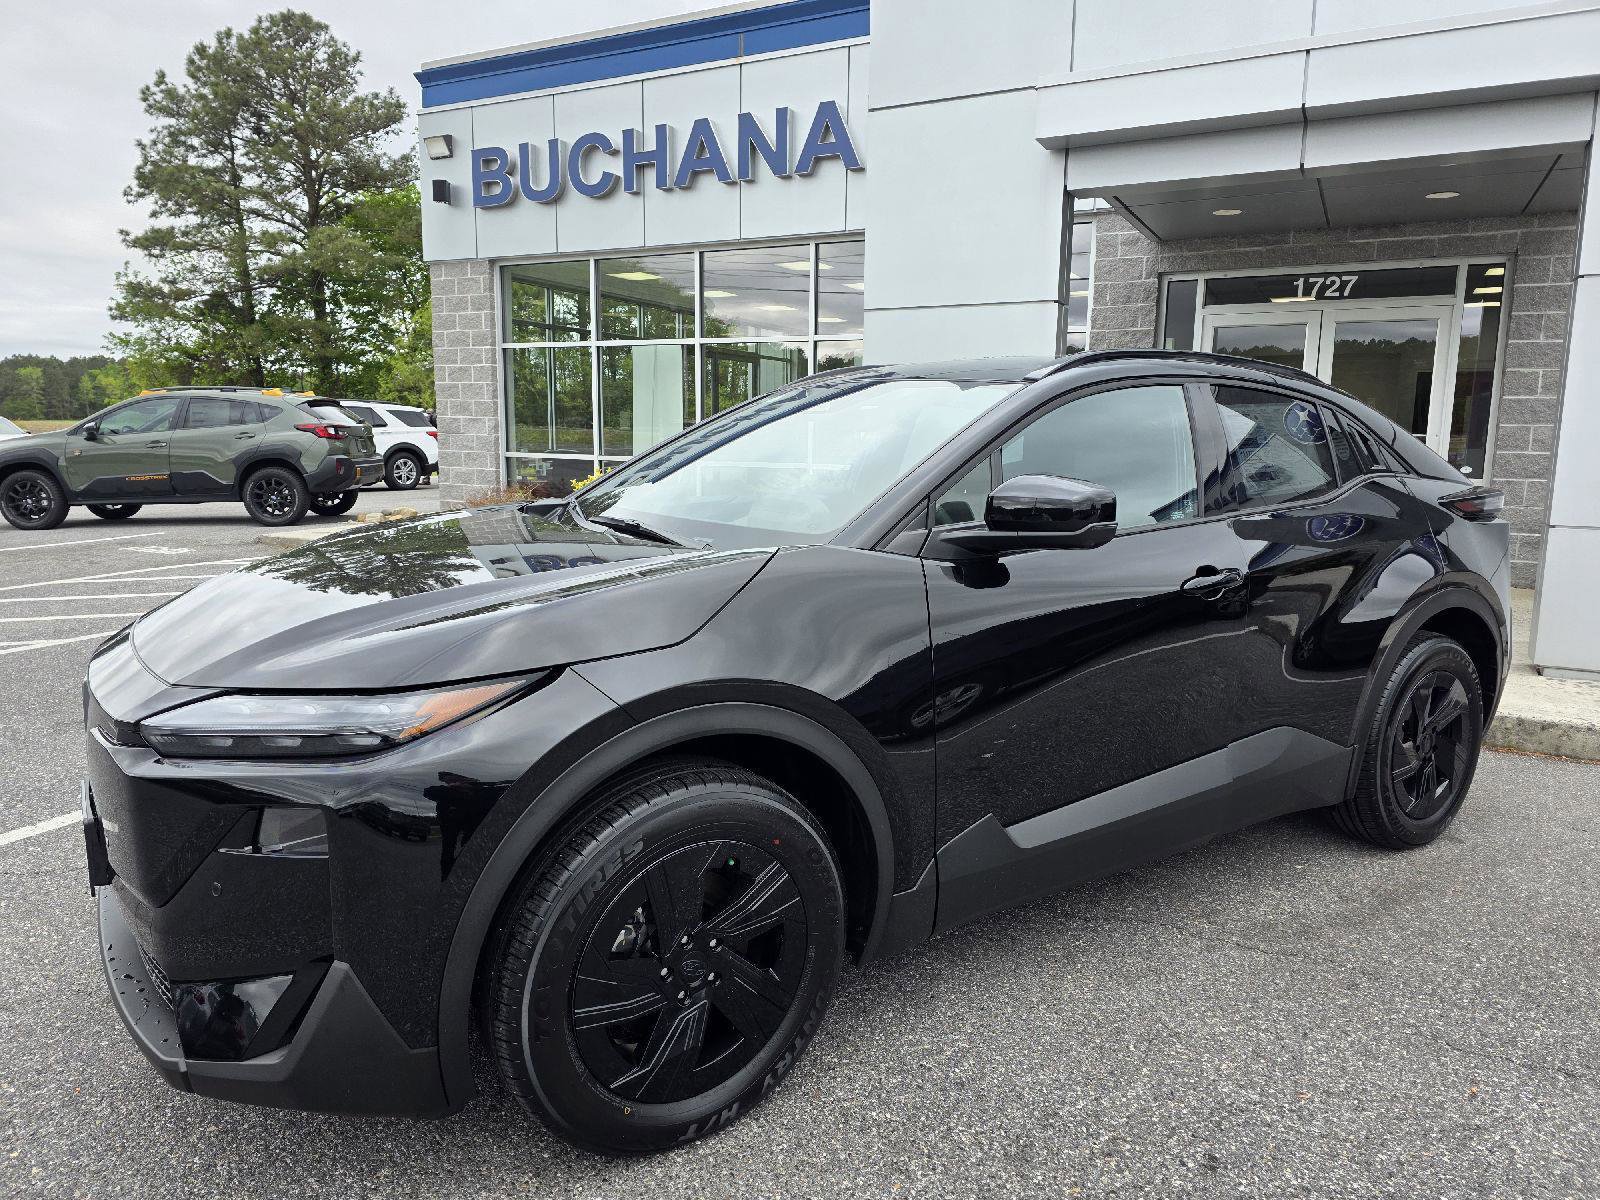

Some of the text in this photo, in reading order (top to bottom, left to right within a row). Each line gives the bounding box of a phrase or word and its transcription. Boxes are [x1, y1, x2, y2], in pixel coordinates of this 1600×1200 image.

[471, 101, 865, 208] BUCHANA
[1293, 275, 1359, 298] 1727
[559, 834, 644, 933] TIRES
